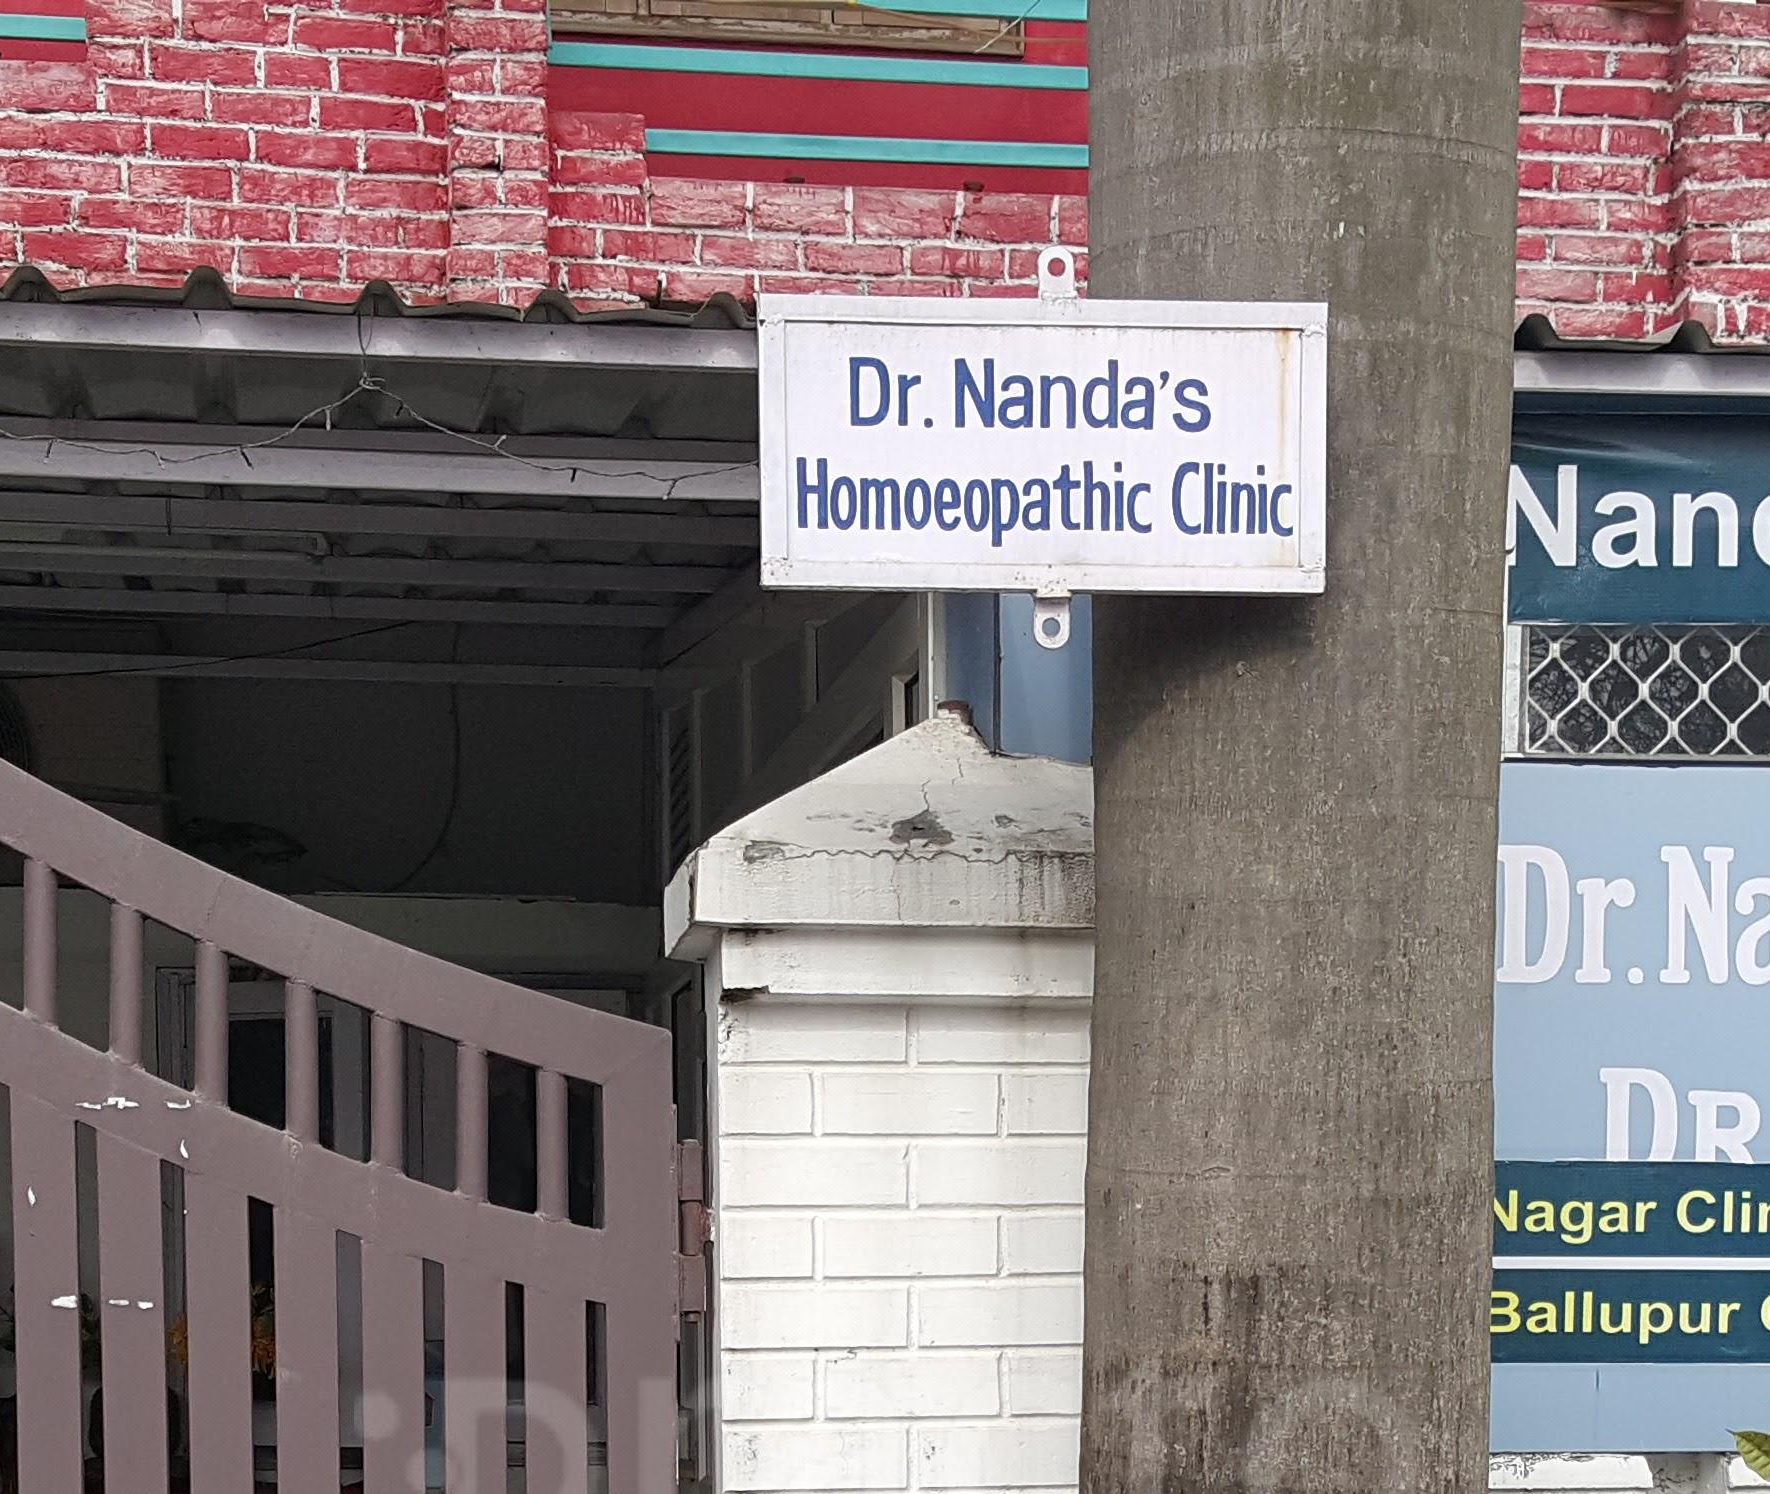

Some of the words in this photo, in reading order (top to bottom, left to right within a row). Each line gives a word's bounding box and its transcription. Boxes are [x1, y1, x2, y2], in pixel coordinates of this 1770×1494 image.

[848, 356, 935, 430] Dr.
[955, 357, 1212, 433] Nanda's
[796, 456, 1153, 548] Homoeopathic
[1171, 461, 1295, 538] Clinic
[1496, 843, 1645, 987] Dr.
[1493, 1189, 1658, 1245] Nagar
[1490, 1290, 1742, 1346] Ballupur
